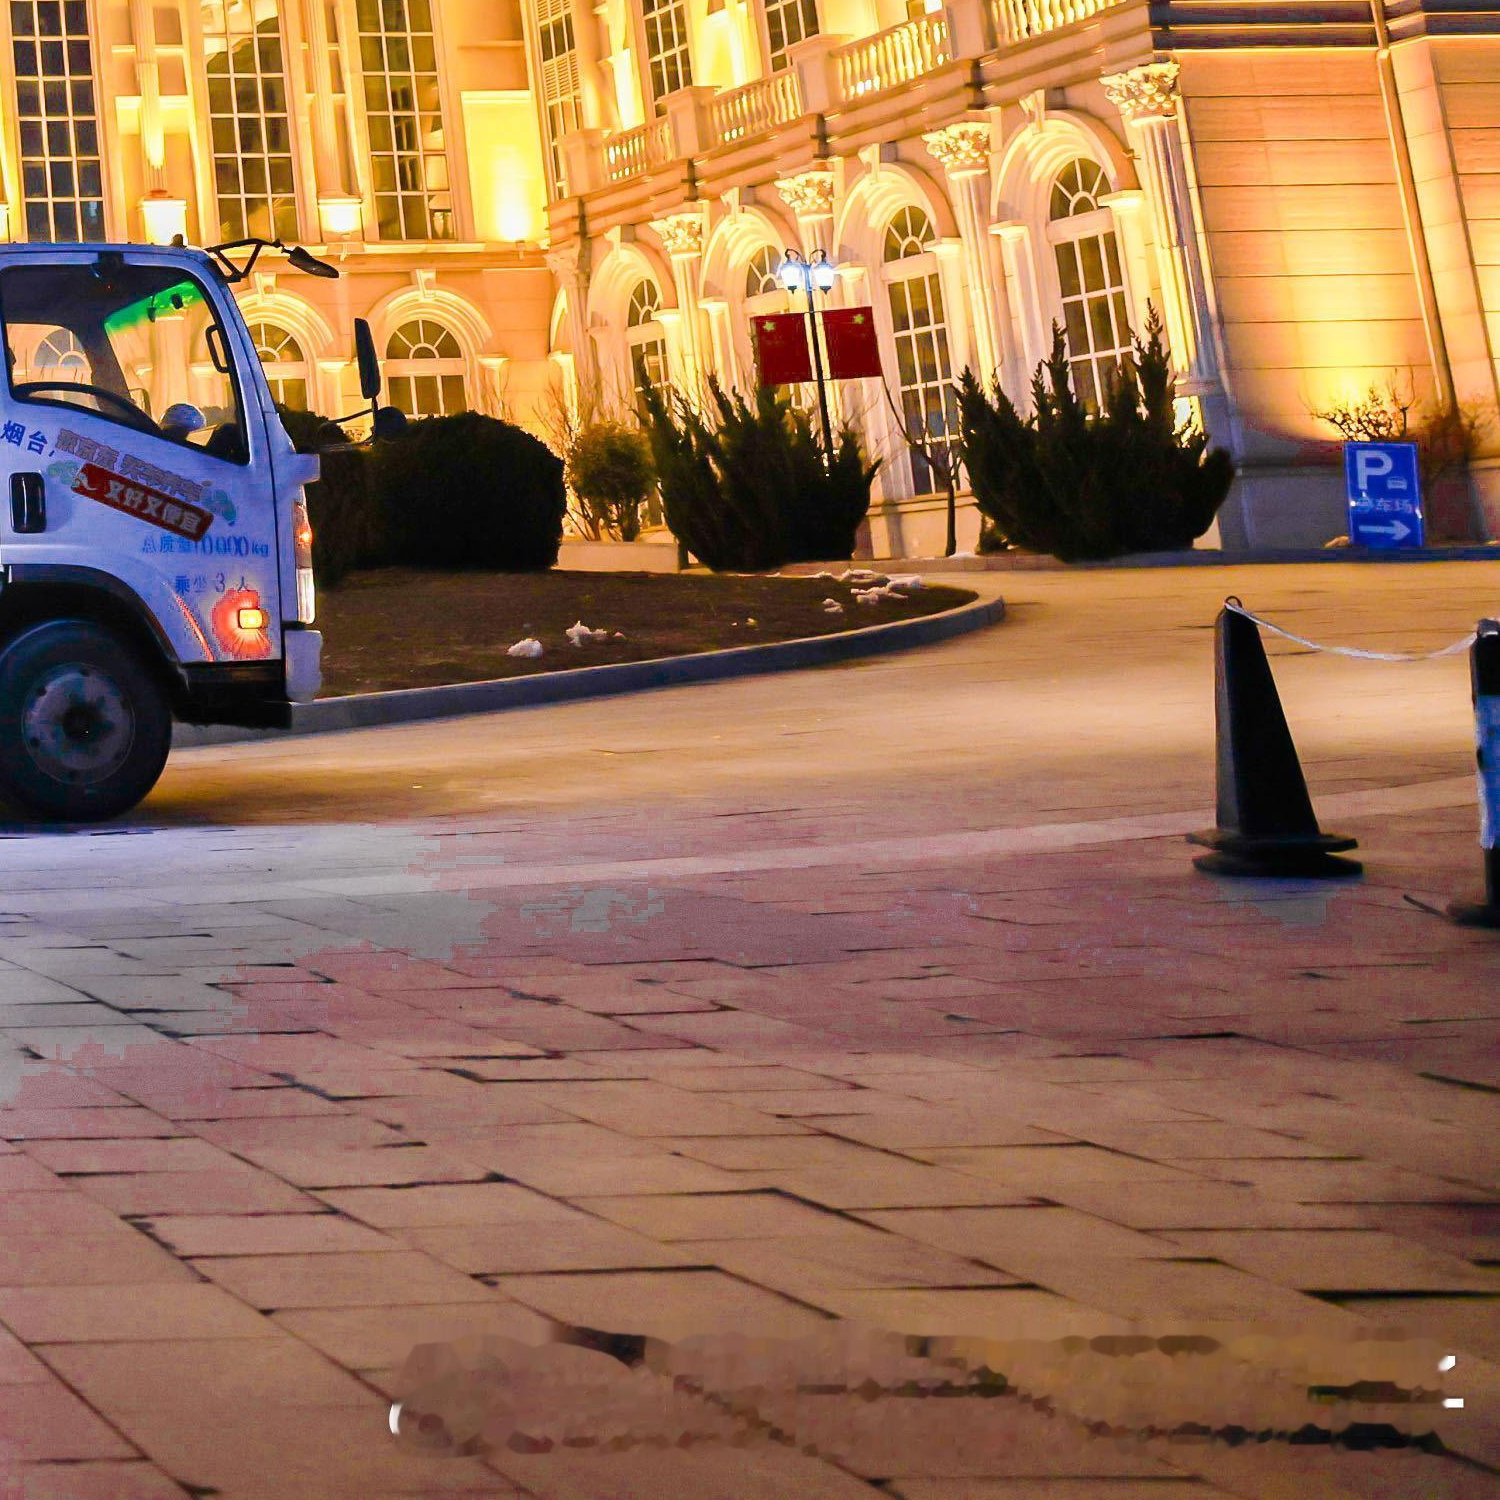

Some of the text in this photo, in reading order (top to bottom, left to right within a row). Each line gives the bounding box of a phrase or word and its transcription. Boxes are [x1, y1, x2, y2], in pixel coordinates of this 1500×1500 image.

[1356, 450, 1393, 490] P
[103, 479, 201, 534] 又好又便宜
